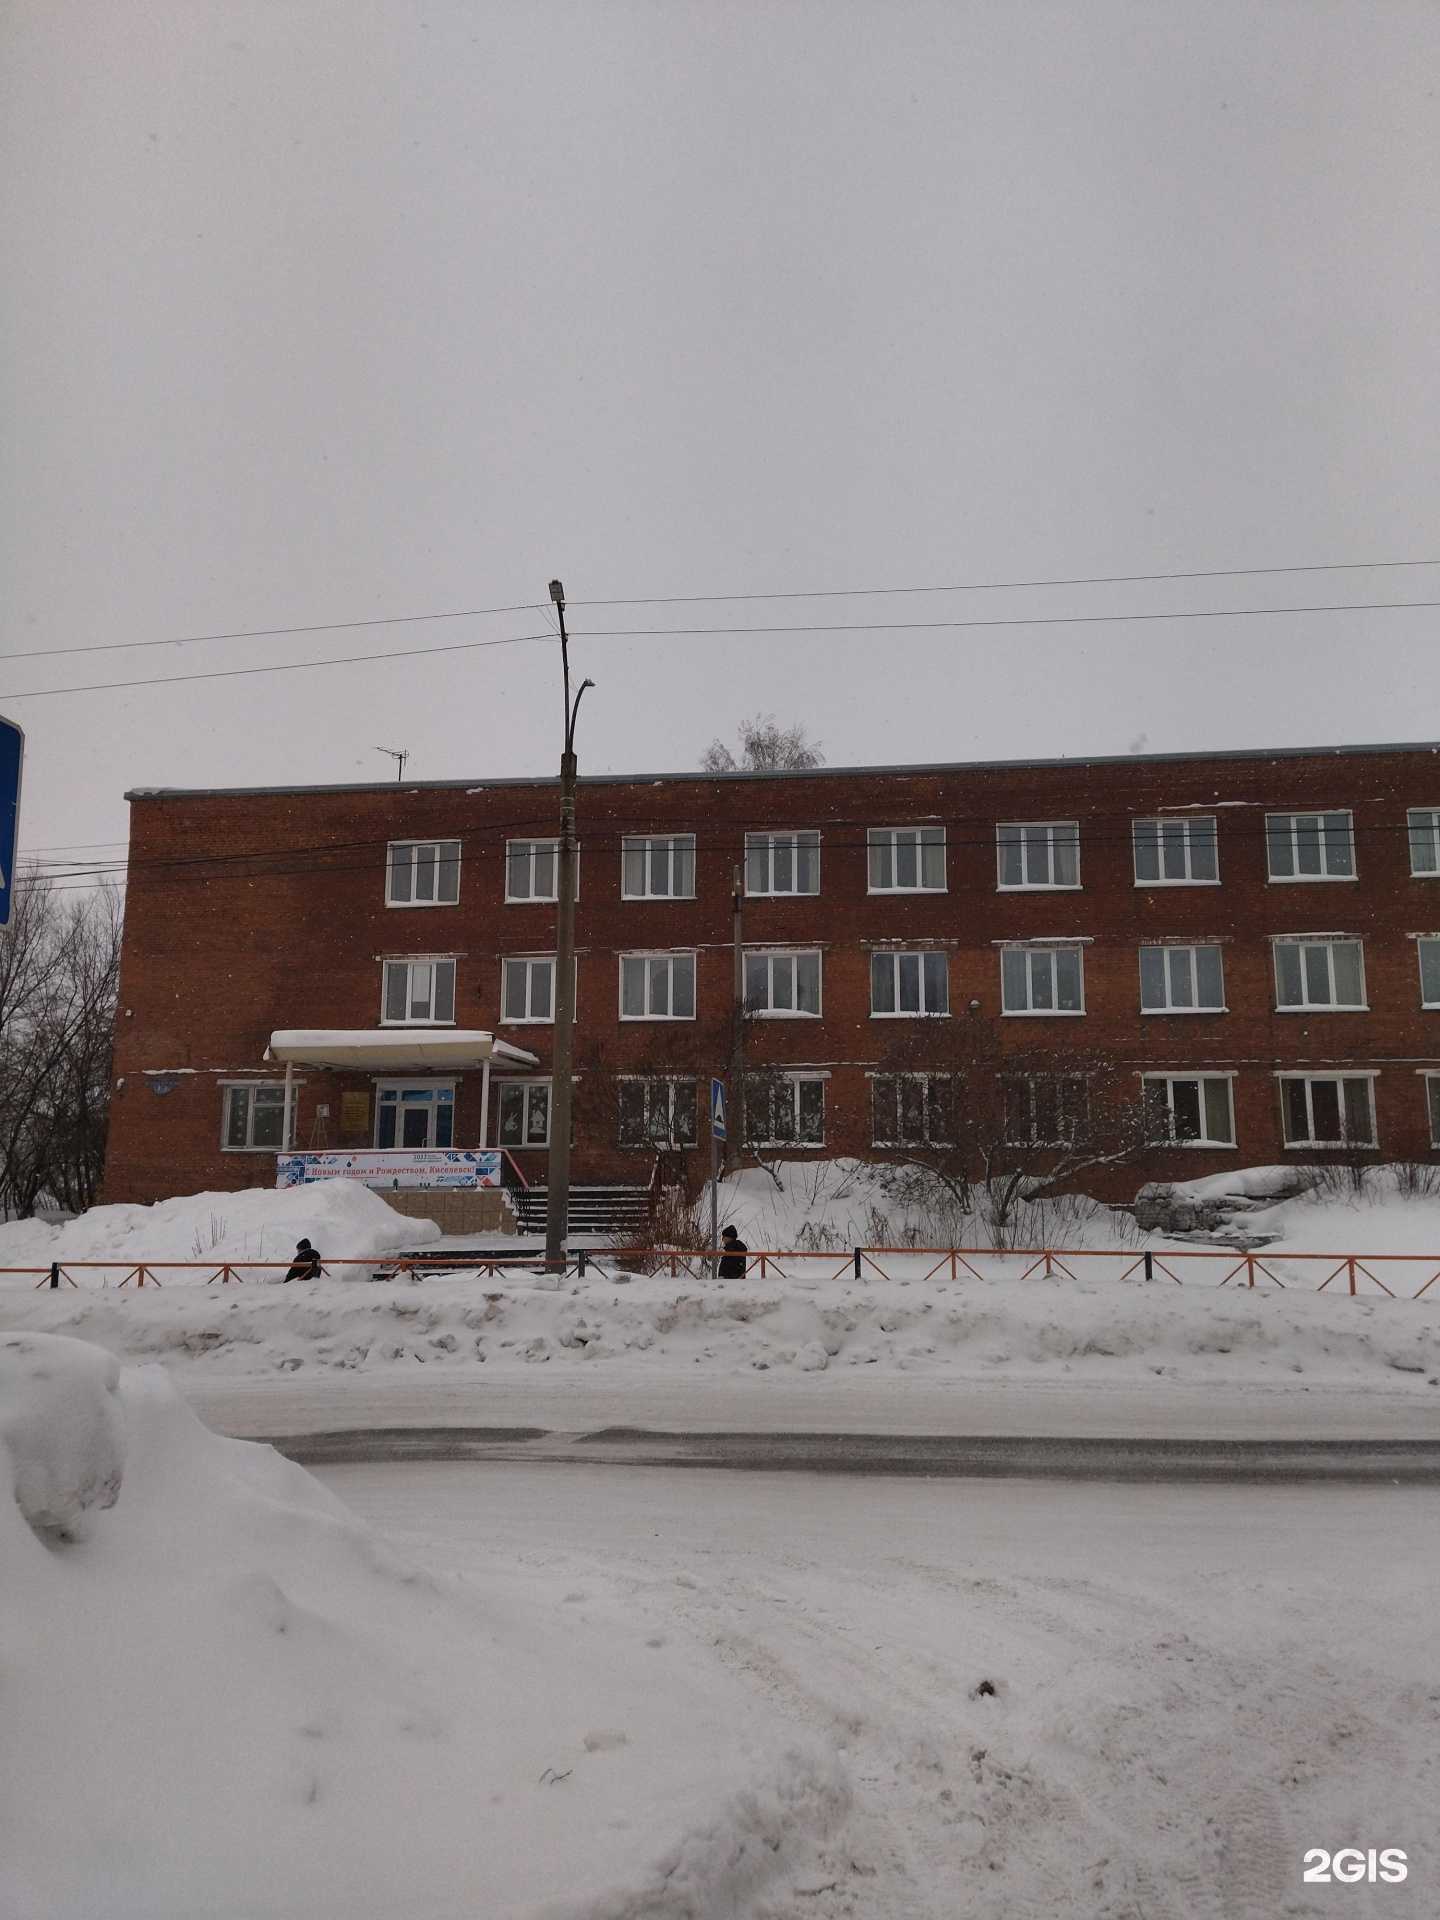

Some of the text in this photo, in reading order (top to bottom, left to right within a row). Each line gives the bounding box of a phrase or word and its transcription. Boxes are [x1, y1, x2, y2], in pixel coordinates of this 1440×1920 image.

[311, 1167, 340, 1176] Новым
[342, 1167, 366, 1177] годом
[368, 1167, 374, 1175] и
